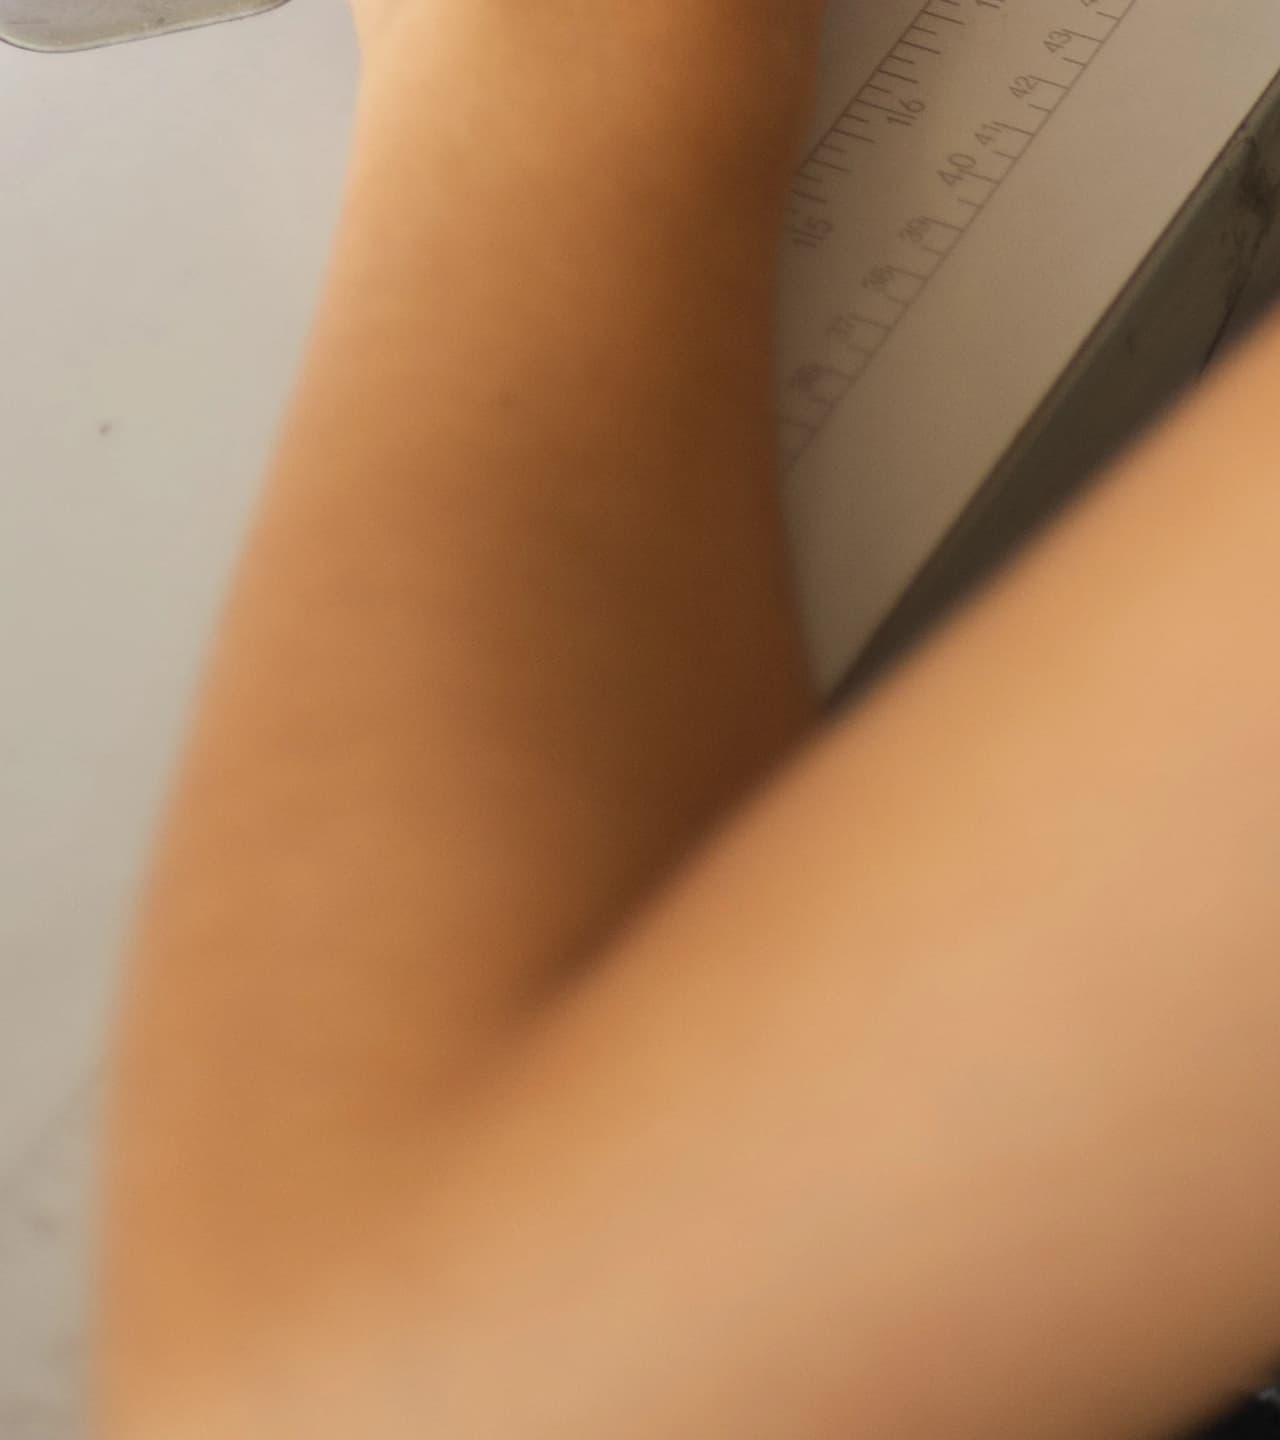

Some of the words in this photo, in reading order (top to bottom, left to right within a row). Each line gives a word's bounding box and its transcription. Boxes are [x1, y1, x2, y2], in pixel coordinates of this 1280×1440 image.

[886, 98, 926, 127] 16
[936, 152, 977, 187] 40
[974, 122, 1002, 146] 41
[1008, 75, 1039, 99] 42
[1043, 29, 1073, 54] 43
